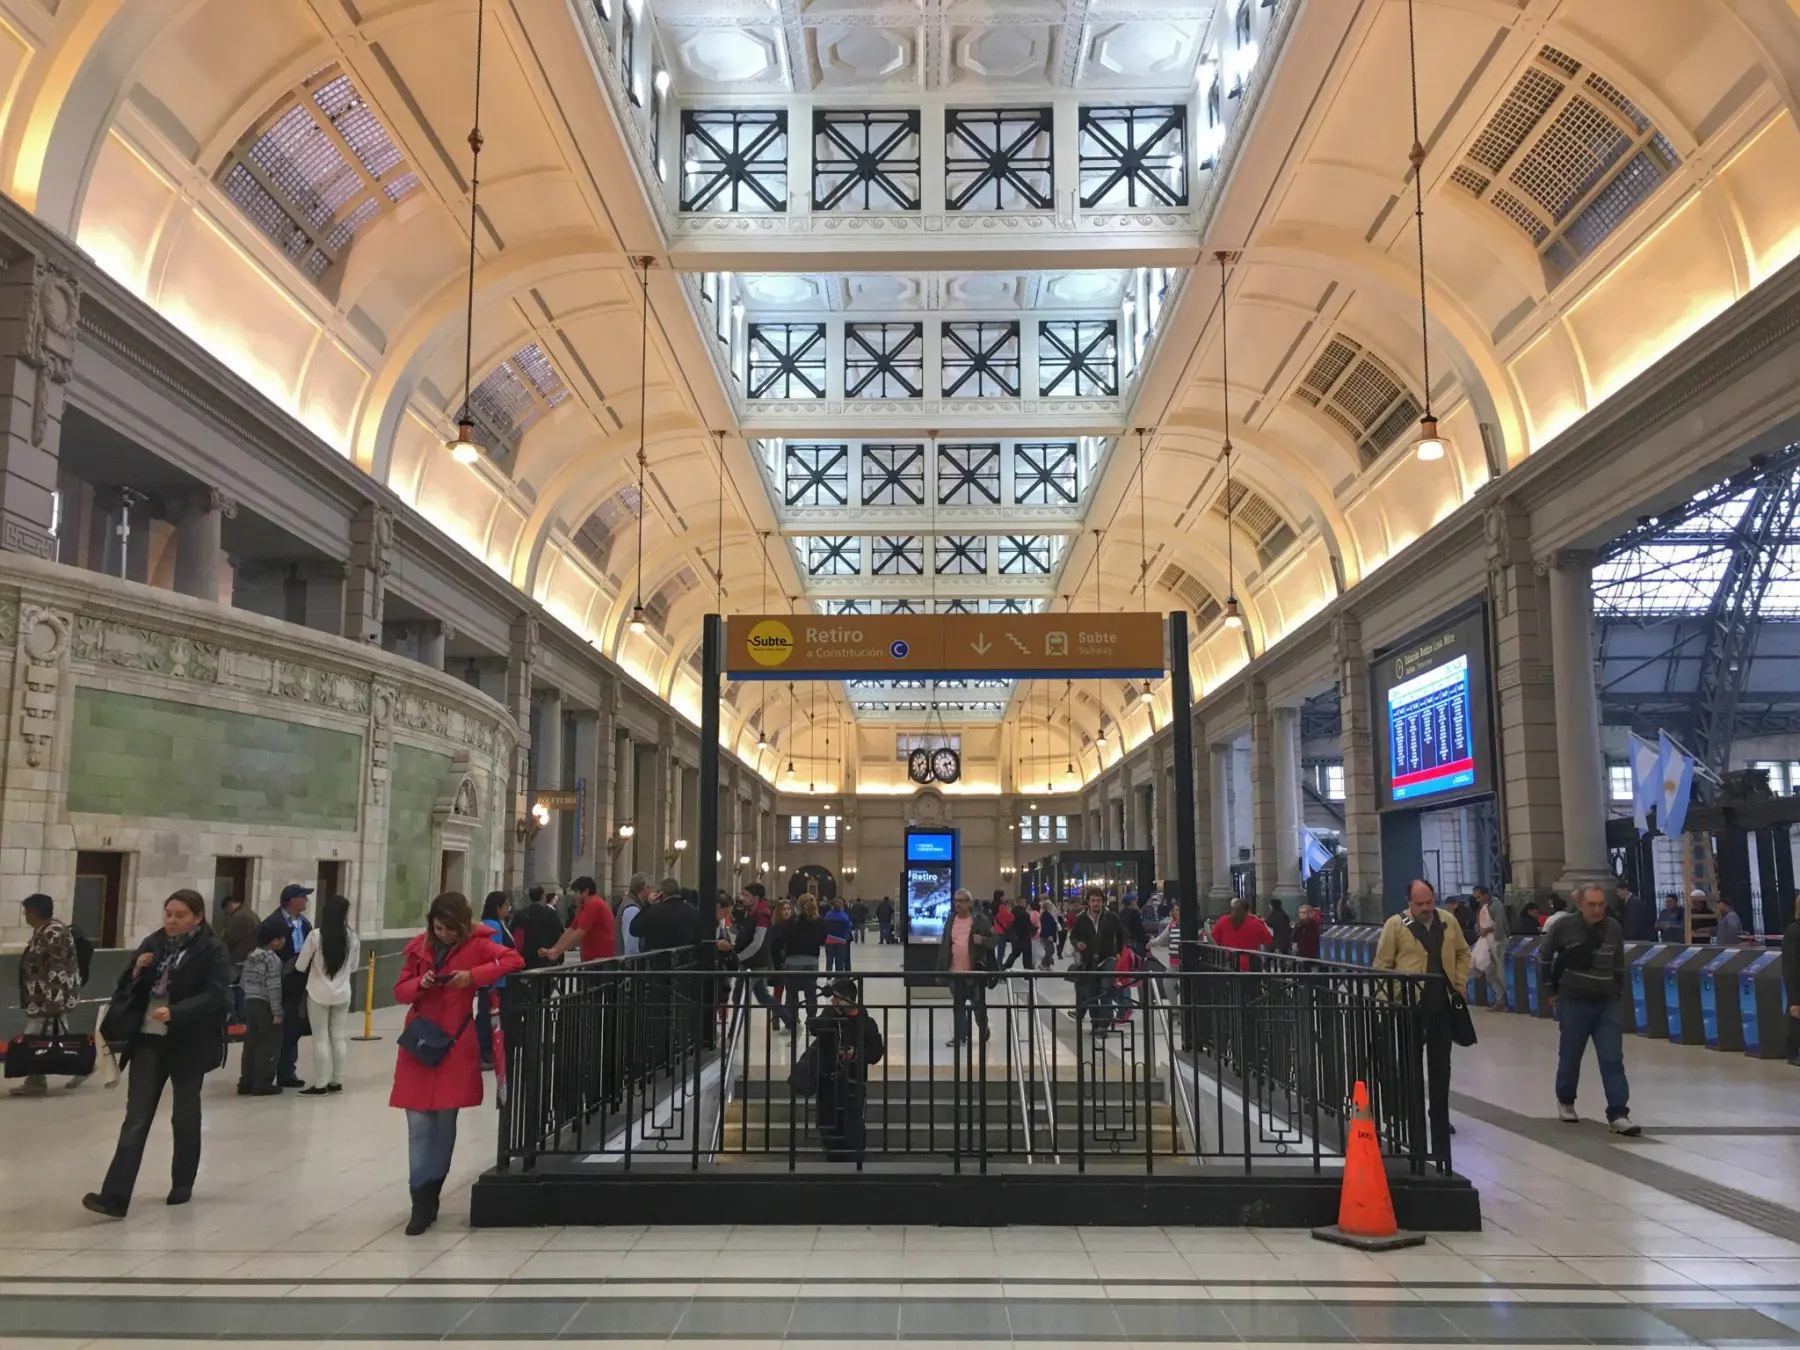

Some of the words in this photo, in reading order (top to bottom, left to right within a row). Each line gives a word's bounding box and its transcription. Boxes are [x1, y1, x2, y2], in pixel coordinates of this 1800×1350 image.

[752, 635, 788, 646] Subte
[806, 627, 863, 643] Retiro
[1079, 631, 1117, 643] Subte
[806, 650, 813, 658] a
[816, 647, 884, 658] Constitución
[894, 643, 903, 655] C
[1079, 646, 1112, 657] Subway
[102, 836, 112, 846] 14
[235, 844, 243, 853] 15
[912, 872, 938, 881] Retiro
